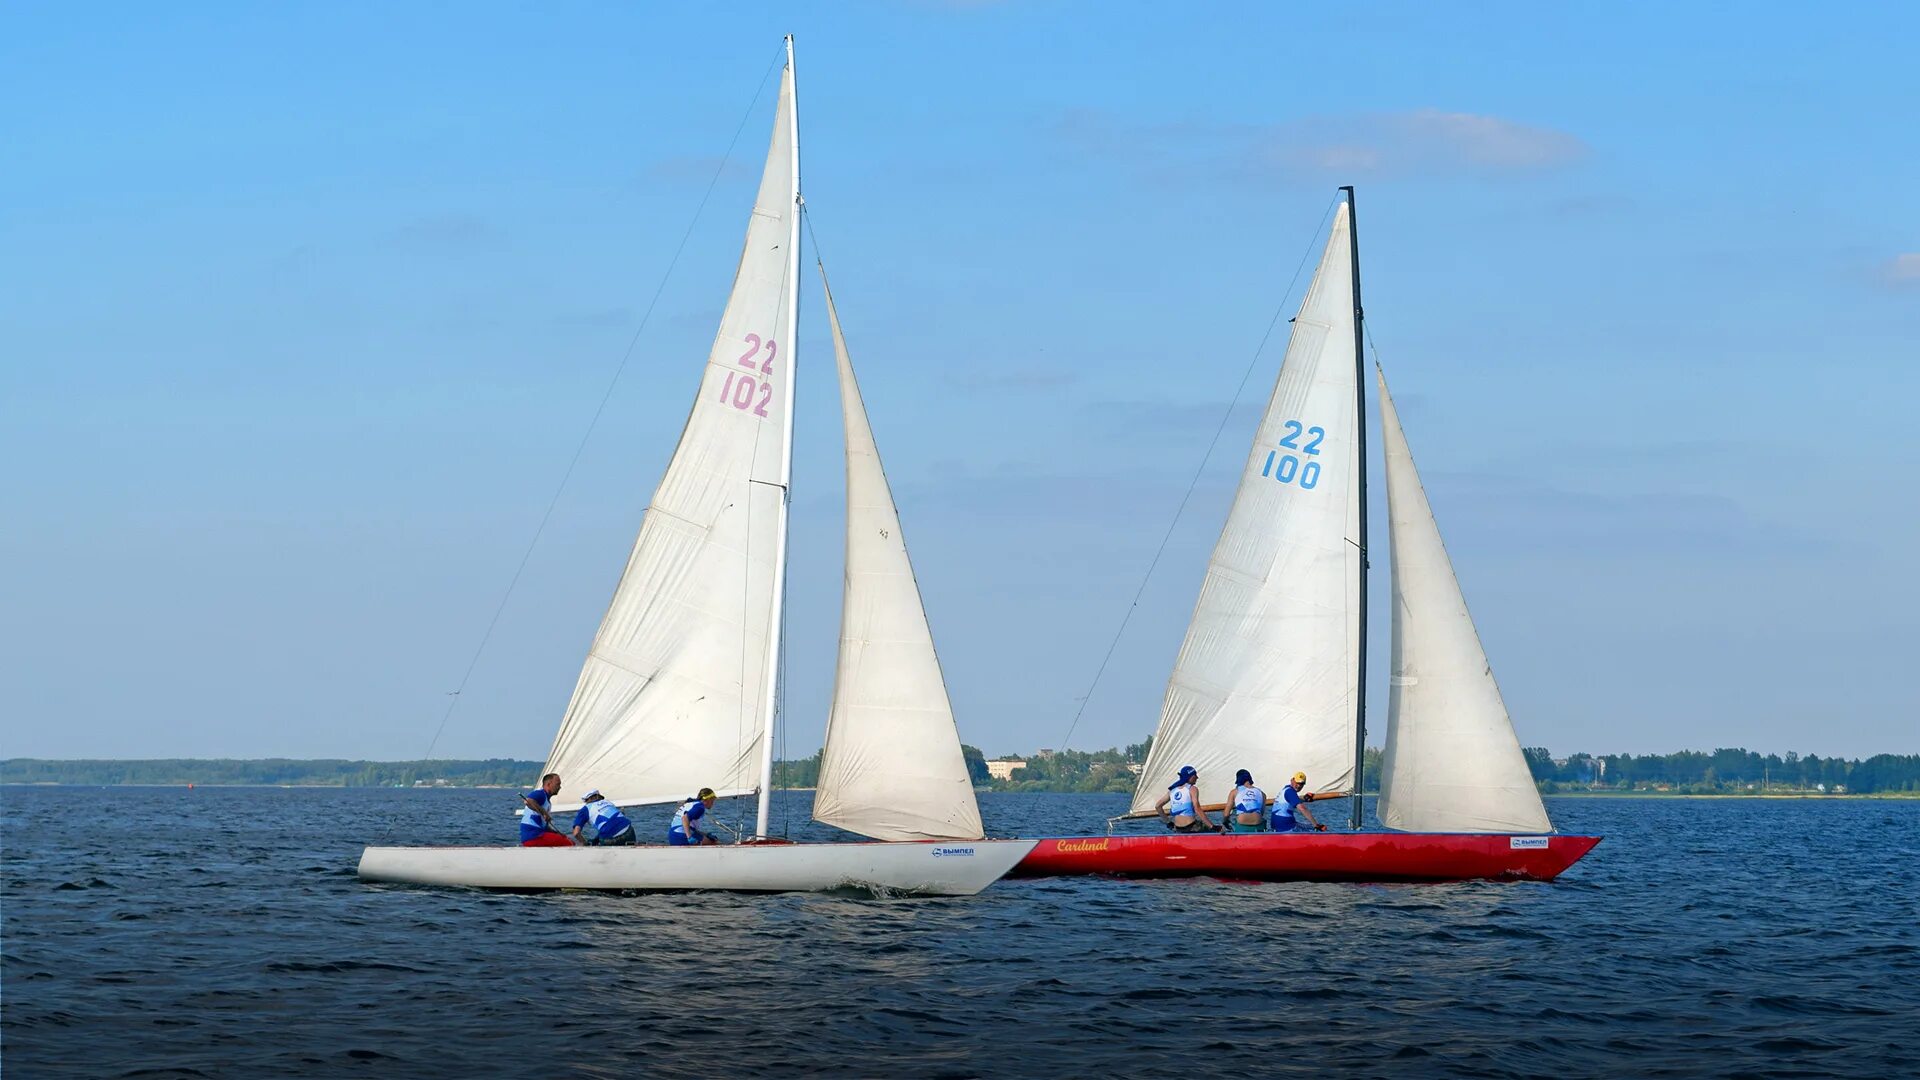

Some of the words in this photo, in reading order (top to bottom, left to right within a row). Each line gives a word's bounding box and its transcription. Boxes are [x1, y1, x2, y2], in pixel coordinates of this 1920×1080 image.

[738, 332, 777, 375] 22
[720, 371, 773, 418] 102
[1279, 419, 1325, 456] 22
[1262, 450, 1321, 490] 100
[1057, 838, 1109, 851] Cardinal
